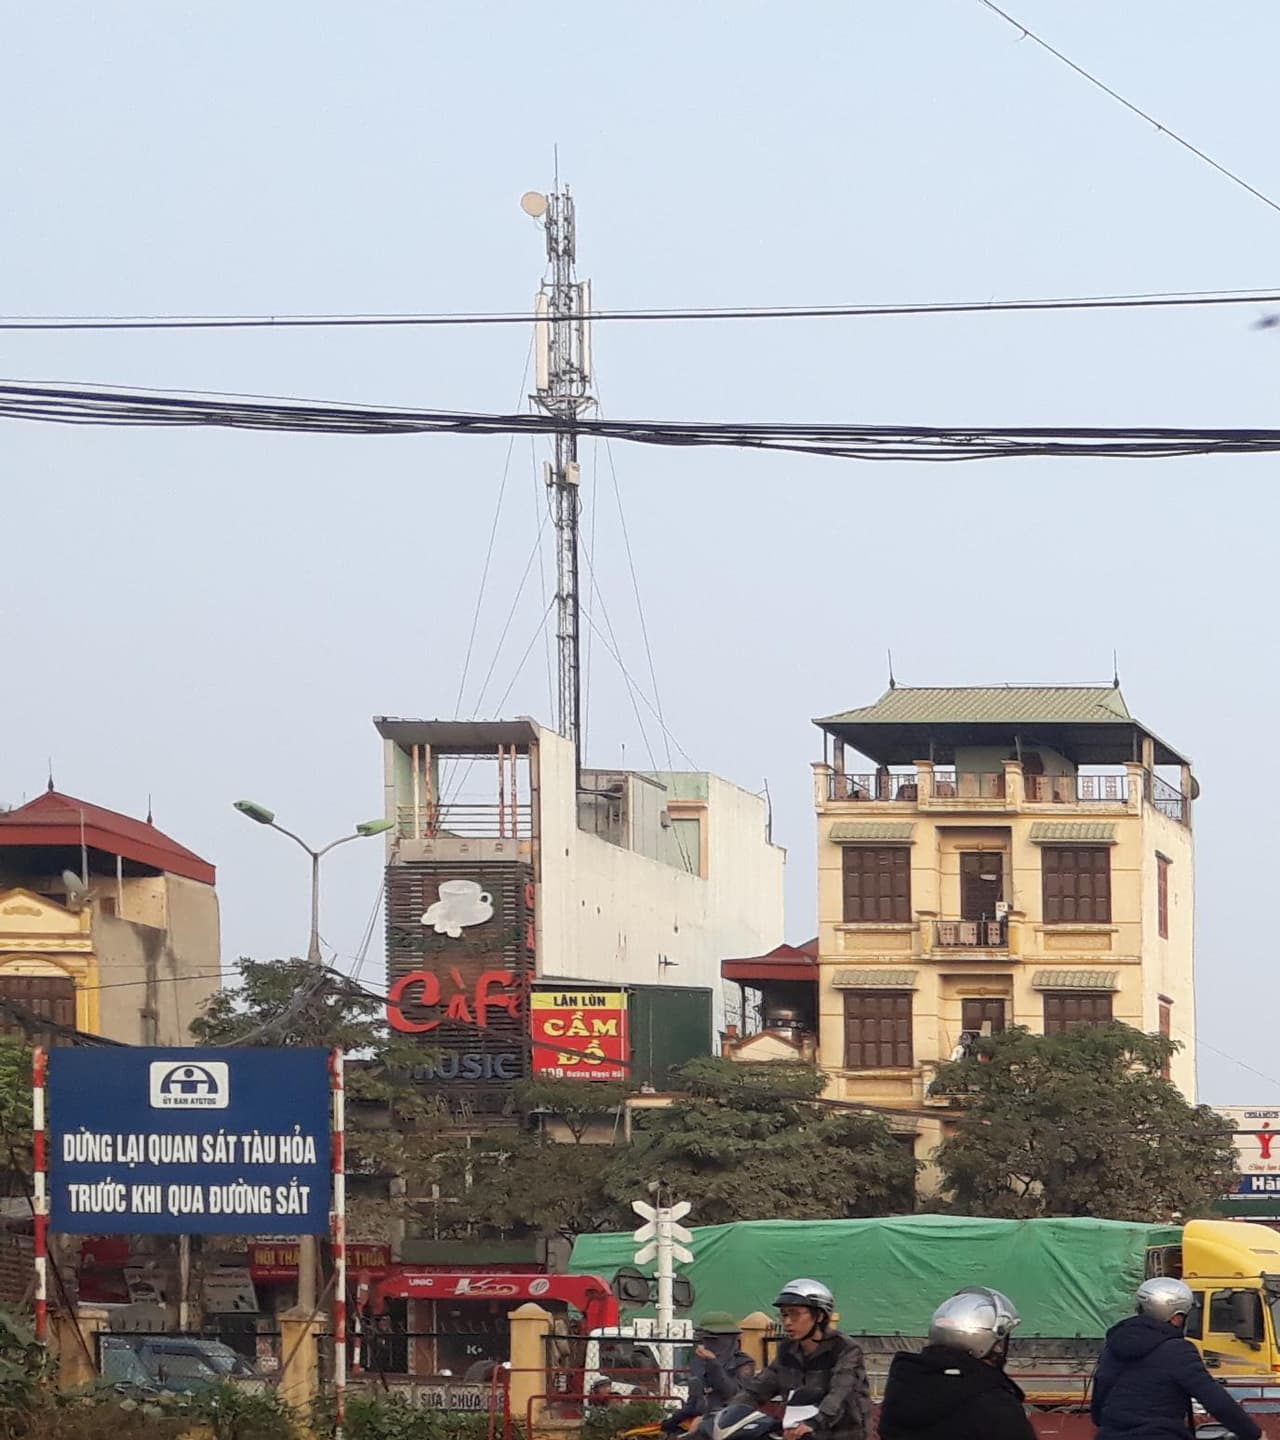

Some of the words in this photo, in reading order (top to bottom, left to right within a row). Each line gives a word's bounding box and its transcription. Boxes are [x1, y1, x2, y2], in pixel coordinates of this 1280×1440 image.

[553, 994, 578, 1006] LÂN
[543, 1011, 618, 1036] CẦM
[63, 1126, 112, 1163] DỪNG
[117, 1134, 144, 1168] LẠI
[148, 1134, 198, 1164] QUAN
[202, 1128, 237, 1164] SÁT
[242, 1129, 276, 1164] TÀU
[280, 1124, 316, 1164] HỎA
[68, 1177, 126, 1213] TRƯỚC
[131, 1184, 162, 1214] KHI
[168, 1185, 204, 1216] QUA
[209, 1177, 272, 1214] ĐƯỜNG
[275, 1176, 310, 1214] SẮT
